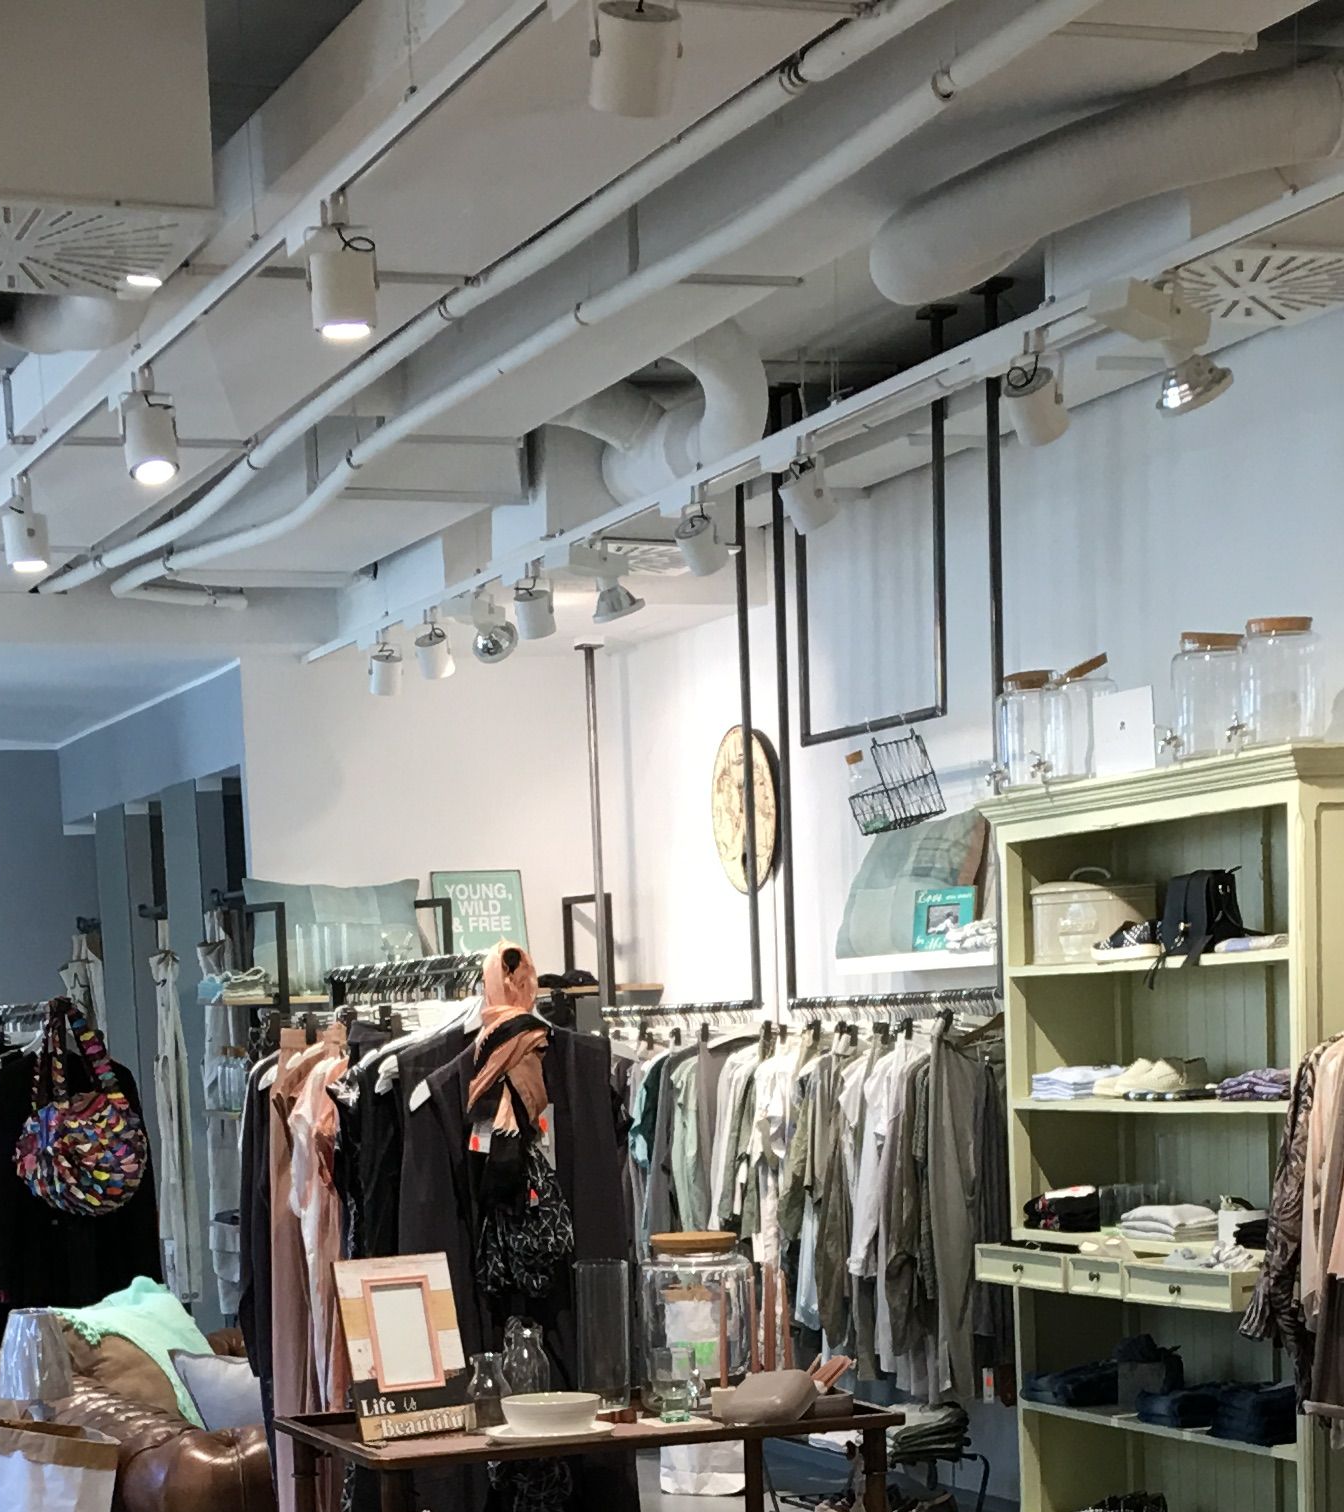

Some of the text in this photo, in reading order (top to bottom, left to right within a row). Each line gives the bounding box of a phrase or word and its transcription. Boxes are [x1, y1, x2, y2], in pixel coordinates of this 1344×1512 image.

[444, 882, 513, 901] YOUNG,
[457, 900, 501, 916] WILD
[452, 915, 512, 933] & FREE
[361, 1396, 397, 1417] Life
[381, 1410, 466, 1438] Beautifu
